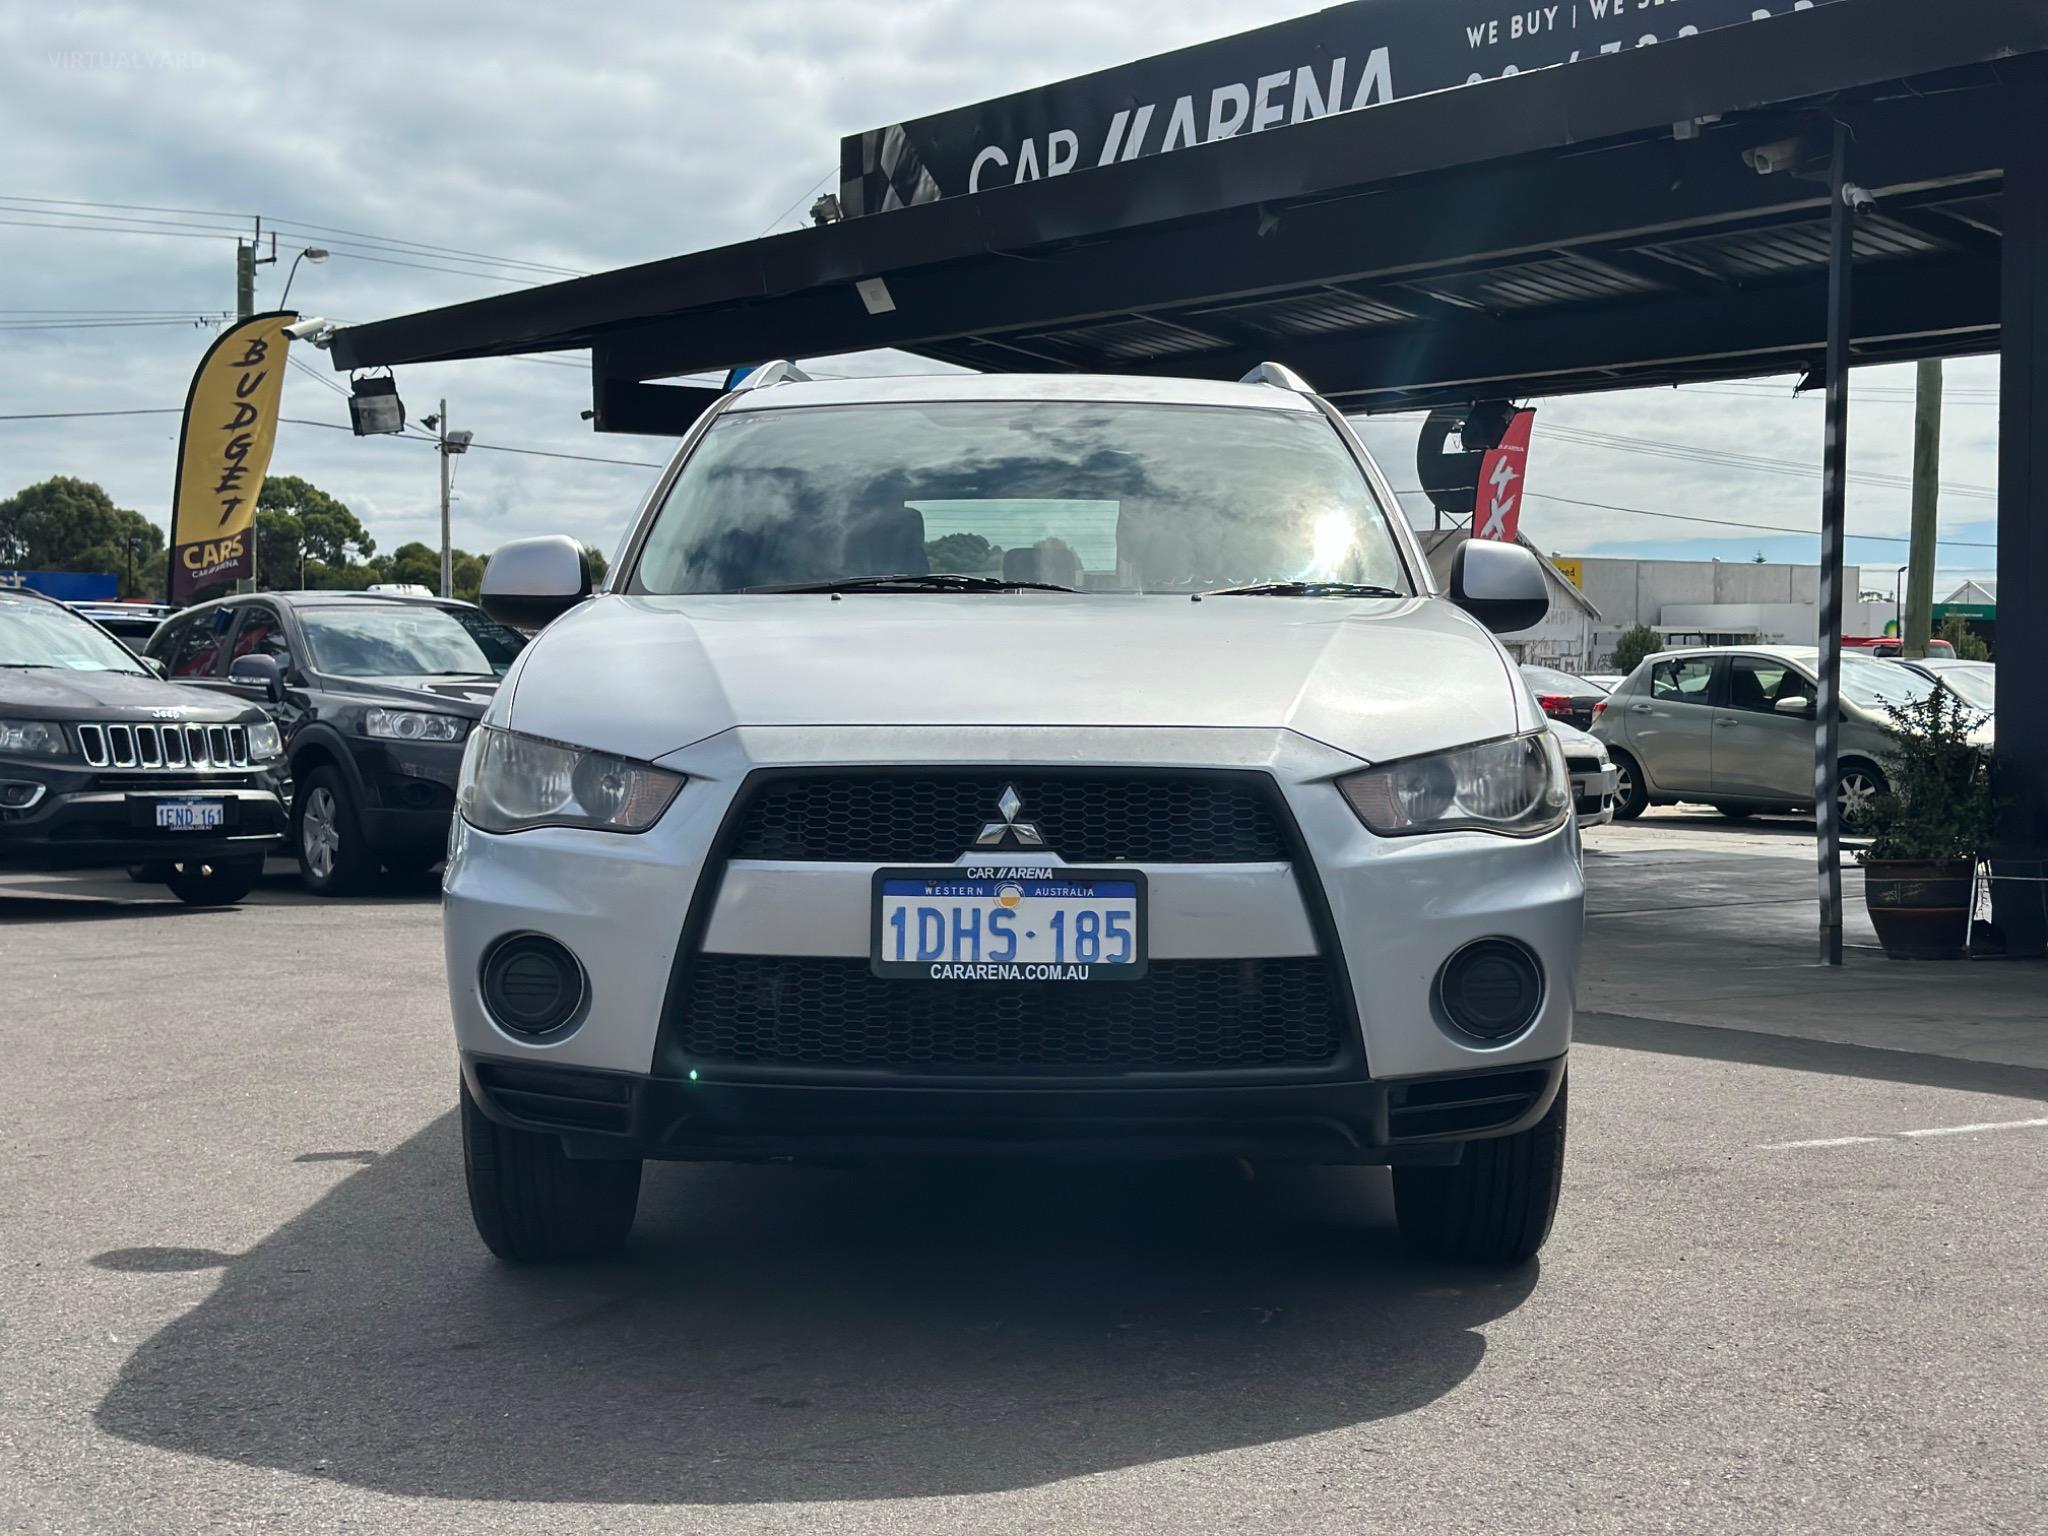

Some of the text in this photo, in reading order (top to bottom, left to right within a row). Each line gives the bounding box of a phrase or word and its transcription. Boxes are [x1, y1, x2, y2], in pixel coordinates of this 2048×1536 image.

[1466, 20, 1498, 49] WE
[1511, 5, 1558, 39] BUY
[1589, 0, 1624, 20] WE
[214, 337, 269, 528] BUDGET
[183, 535, 244, 570] CARS
[151, 708, 180, 720] Jeep
[967, 868, 994, 879] CAR
[925, 887, 1094, 897] WESTERN AUSTRALIA
[930, 963, 1089, 980] CARARENA.COM.AU
